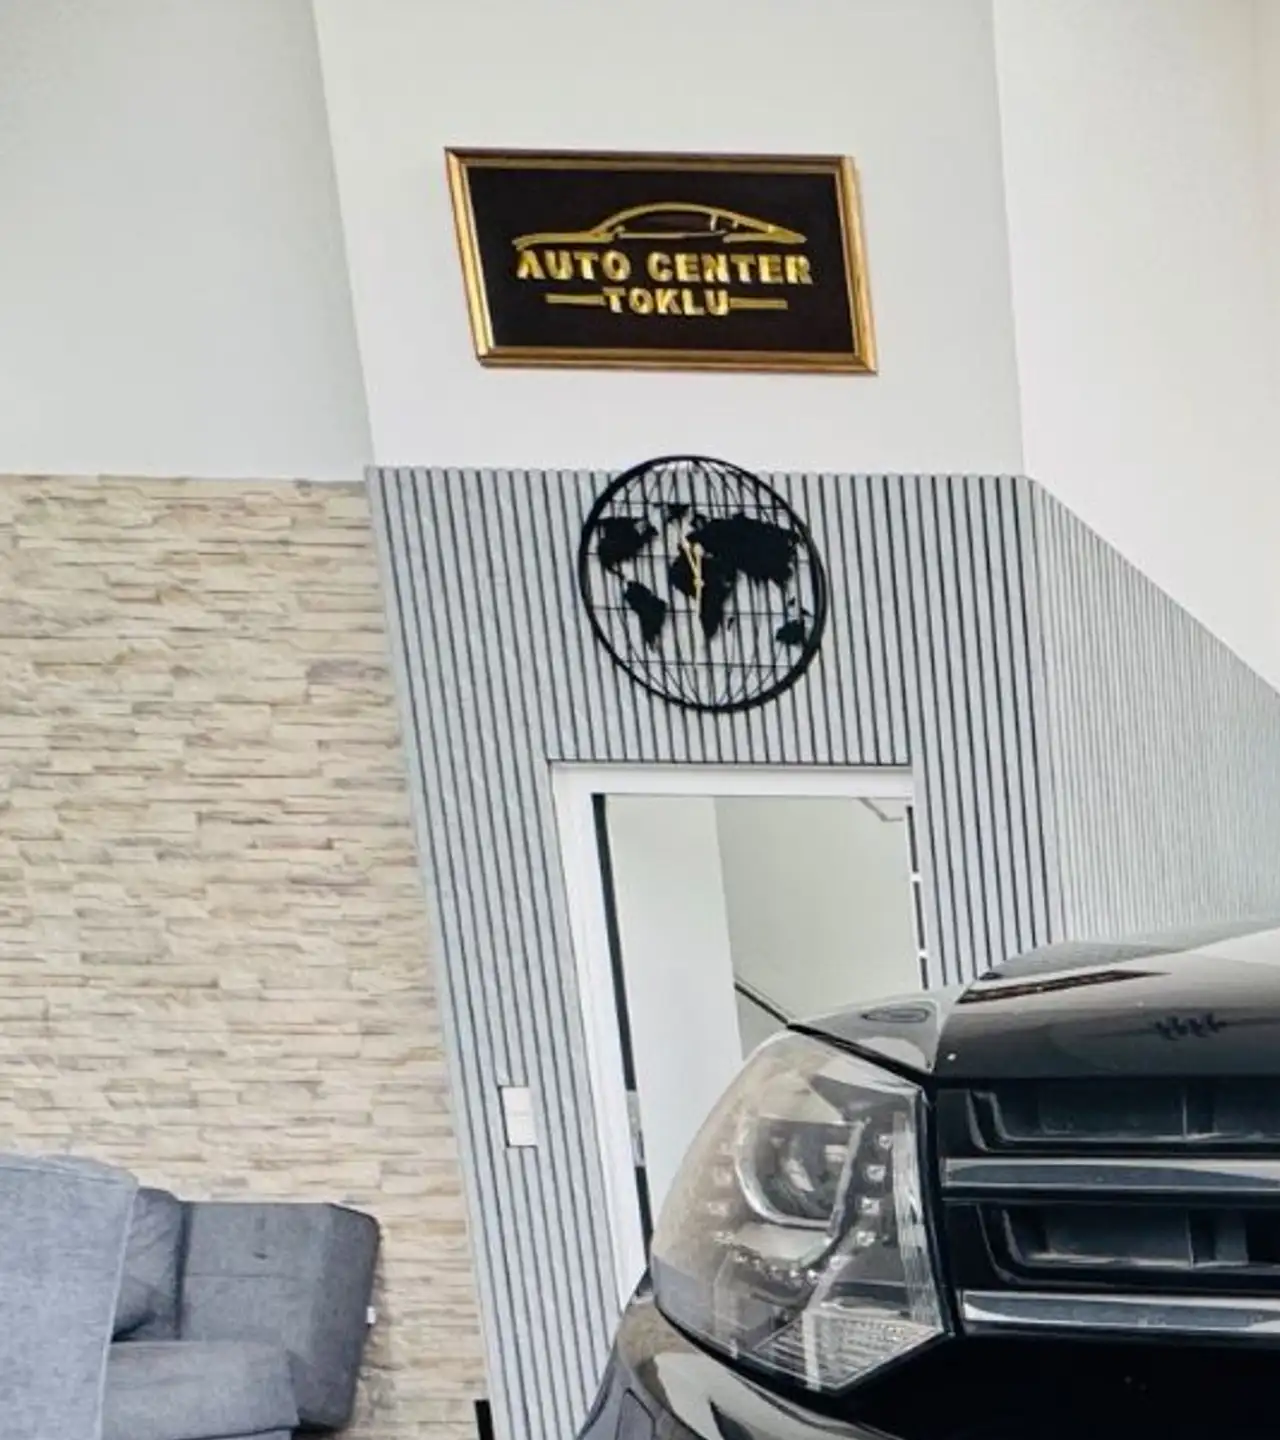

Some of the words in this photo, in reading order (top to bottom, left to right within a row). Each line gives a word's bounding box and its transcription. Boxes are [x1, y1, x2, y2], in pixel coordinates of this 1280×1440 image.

[516, 249, 631, 281] AUTO
[647, 250, 813, 285] CENTER
[602, 286, 731, 316] TOKLU
